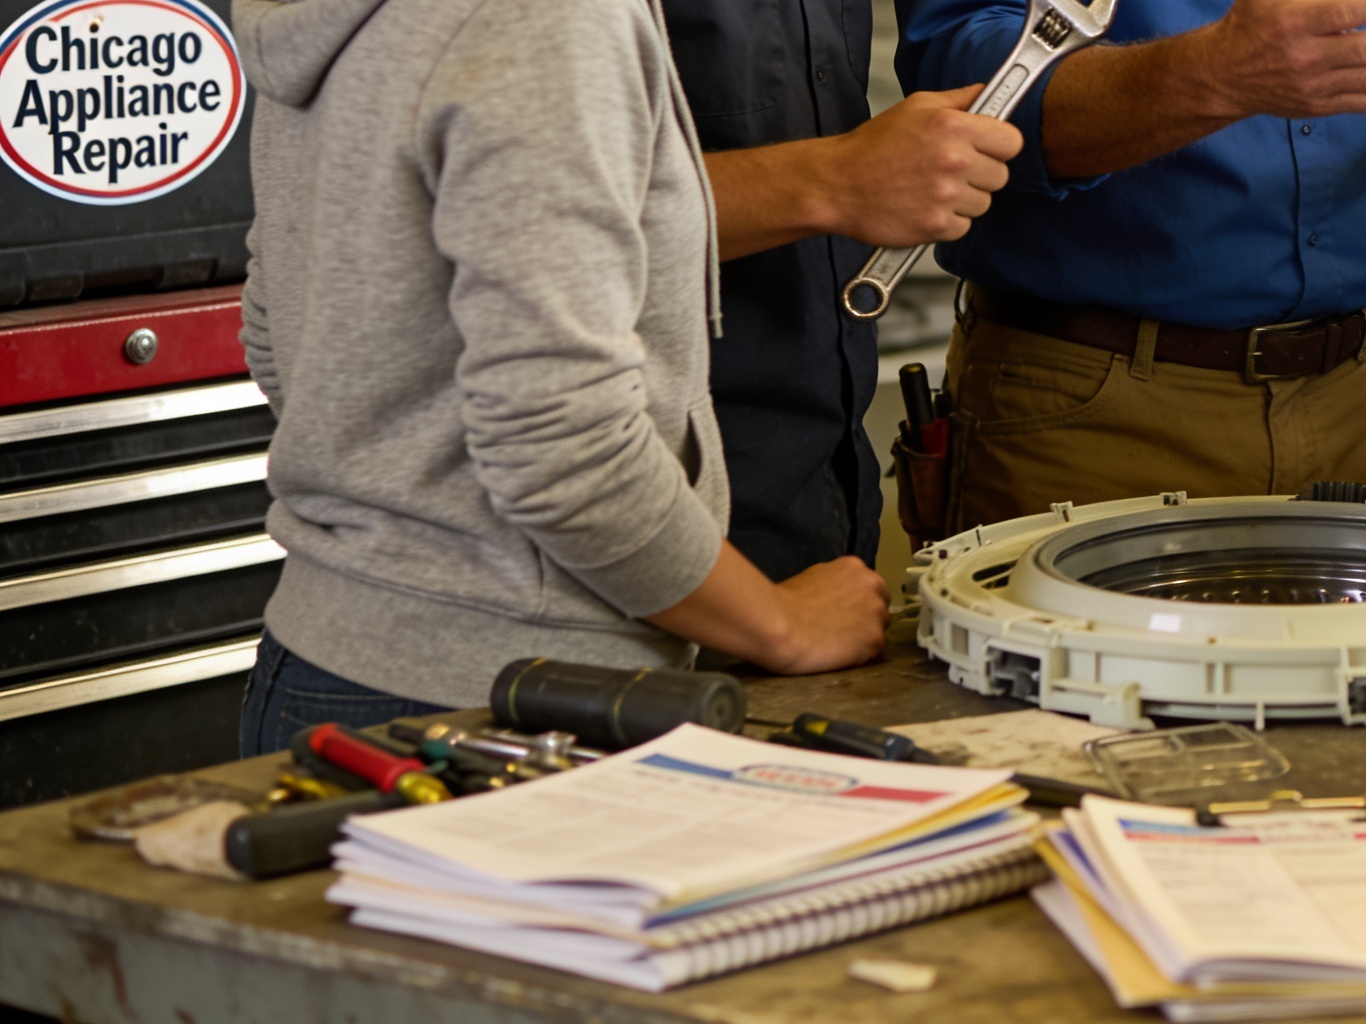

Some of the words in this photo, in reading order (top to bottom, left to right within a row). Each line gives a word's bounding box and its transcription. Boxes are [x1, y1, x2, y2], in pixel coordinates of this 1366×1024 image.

[25, 22, 202, 76] Chicago
[12, 75, 221, 135] Appliance
[53, 122, 188, 184] Repair
